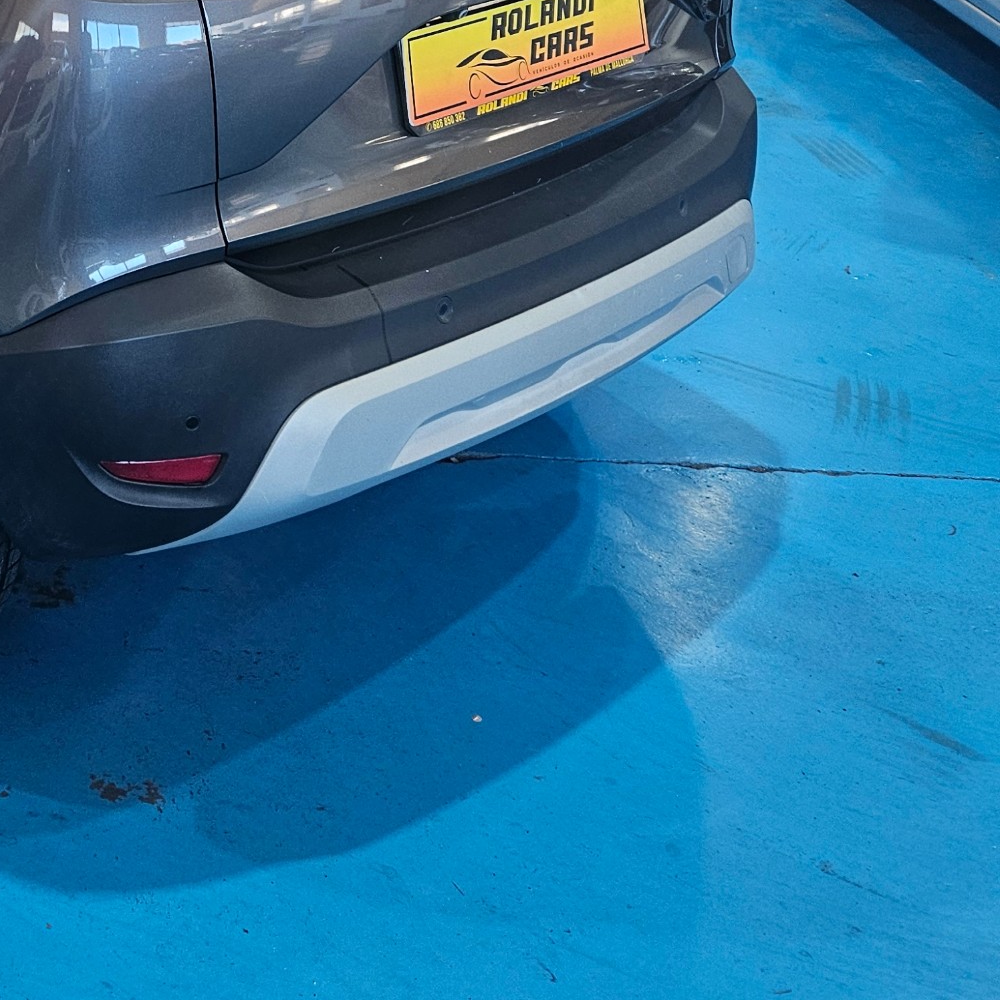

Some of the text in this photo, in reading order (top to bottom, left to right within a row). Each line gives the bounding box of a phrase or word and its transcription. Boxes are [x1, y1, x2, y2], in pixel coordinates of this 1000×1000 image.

[530, 21, 595, 66] CARS
[551, 73, 580, 91] CARS
[477, 90, 528, 115] ROLANDI
